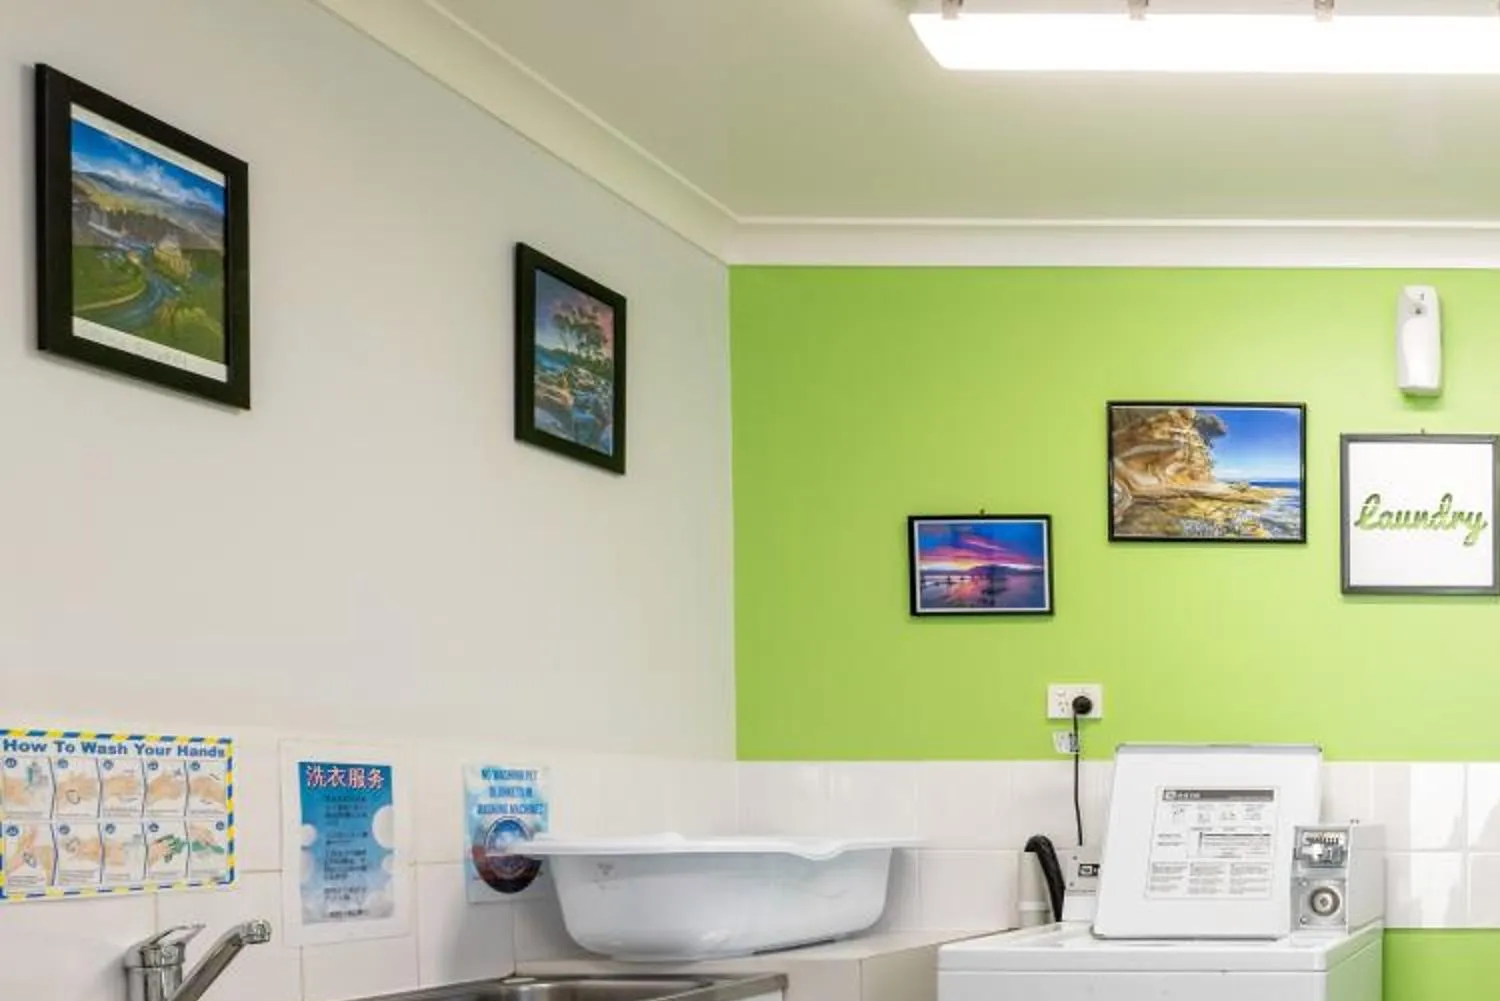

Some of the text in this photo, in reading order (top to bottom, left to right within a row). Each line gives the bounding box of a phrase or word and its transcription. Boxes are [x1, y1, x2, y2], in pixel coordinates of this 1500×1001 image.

[1354, 492, 1488, 547] Laundry
[3, 738, 225, 758] How To Wash Your Hands
[306, 765, 385, 790] 洗衣服务
